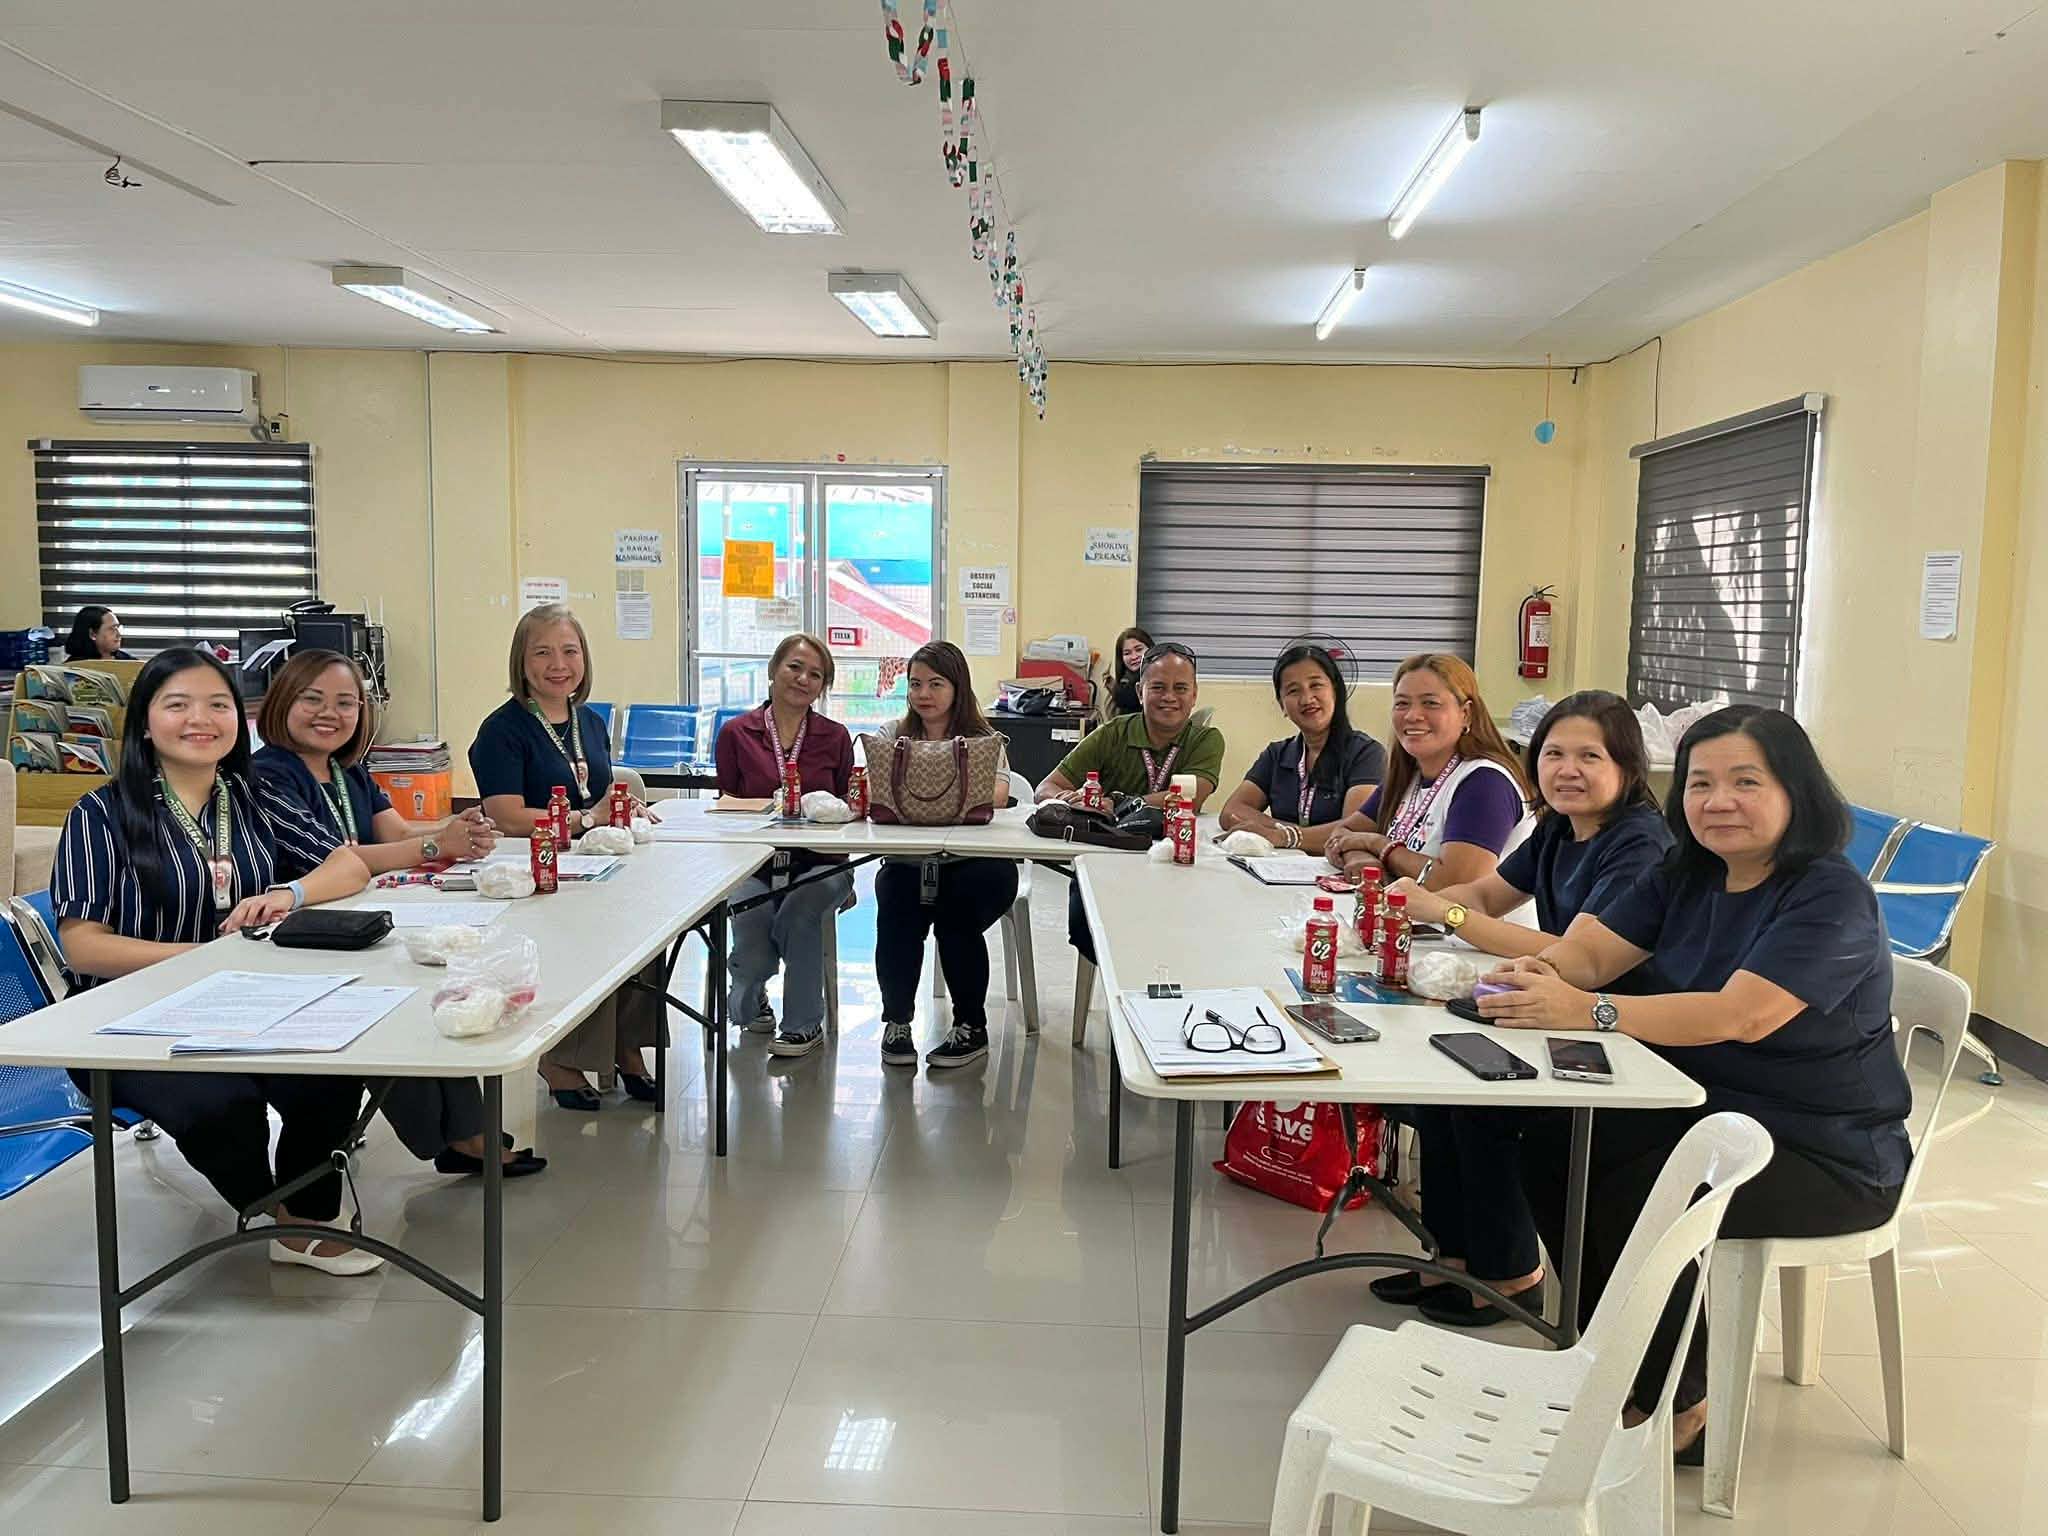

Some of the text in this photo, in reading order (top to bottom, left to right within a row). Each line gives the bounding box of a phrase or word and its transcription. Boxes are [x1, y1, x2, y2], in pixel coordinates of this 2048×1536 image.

[1092, 541, 1129, 550] SMOKING
[970, 572, 996, 580] OBSERVE
[972, 582, 993, 590] SOCIAL
[964, 591, 1001, 600] DISTANCING
[1178, 828, 1193, 842] C2
[538, 849, 554, 865] C2
[1395, 934, 1411, 953] C2
[1311, 940, 1331, 960] C2
